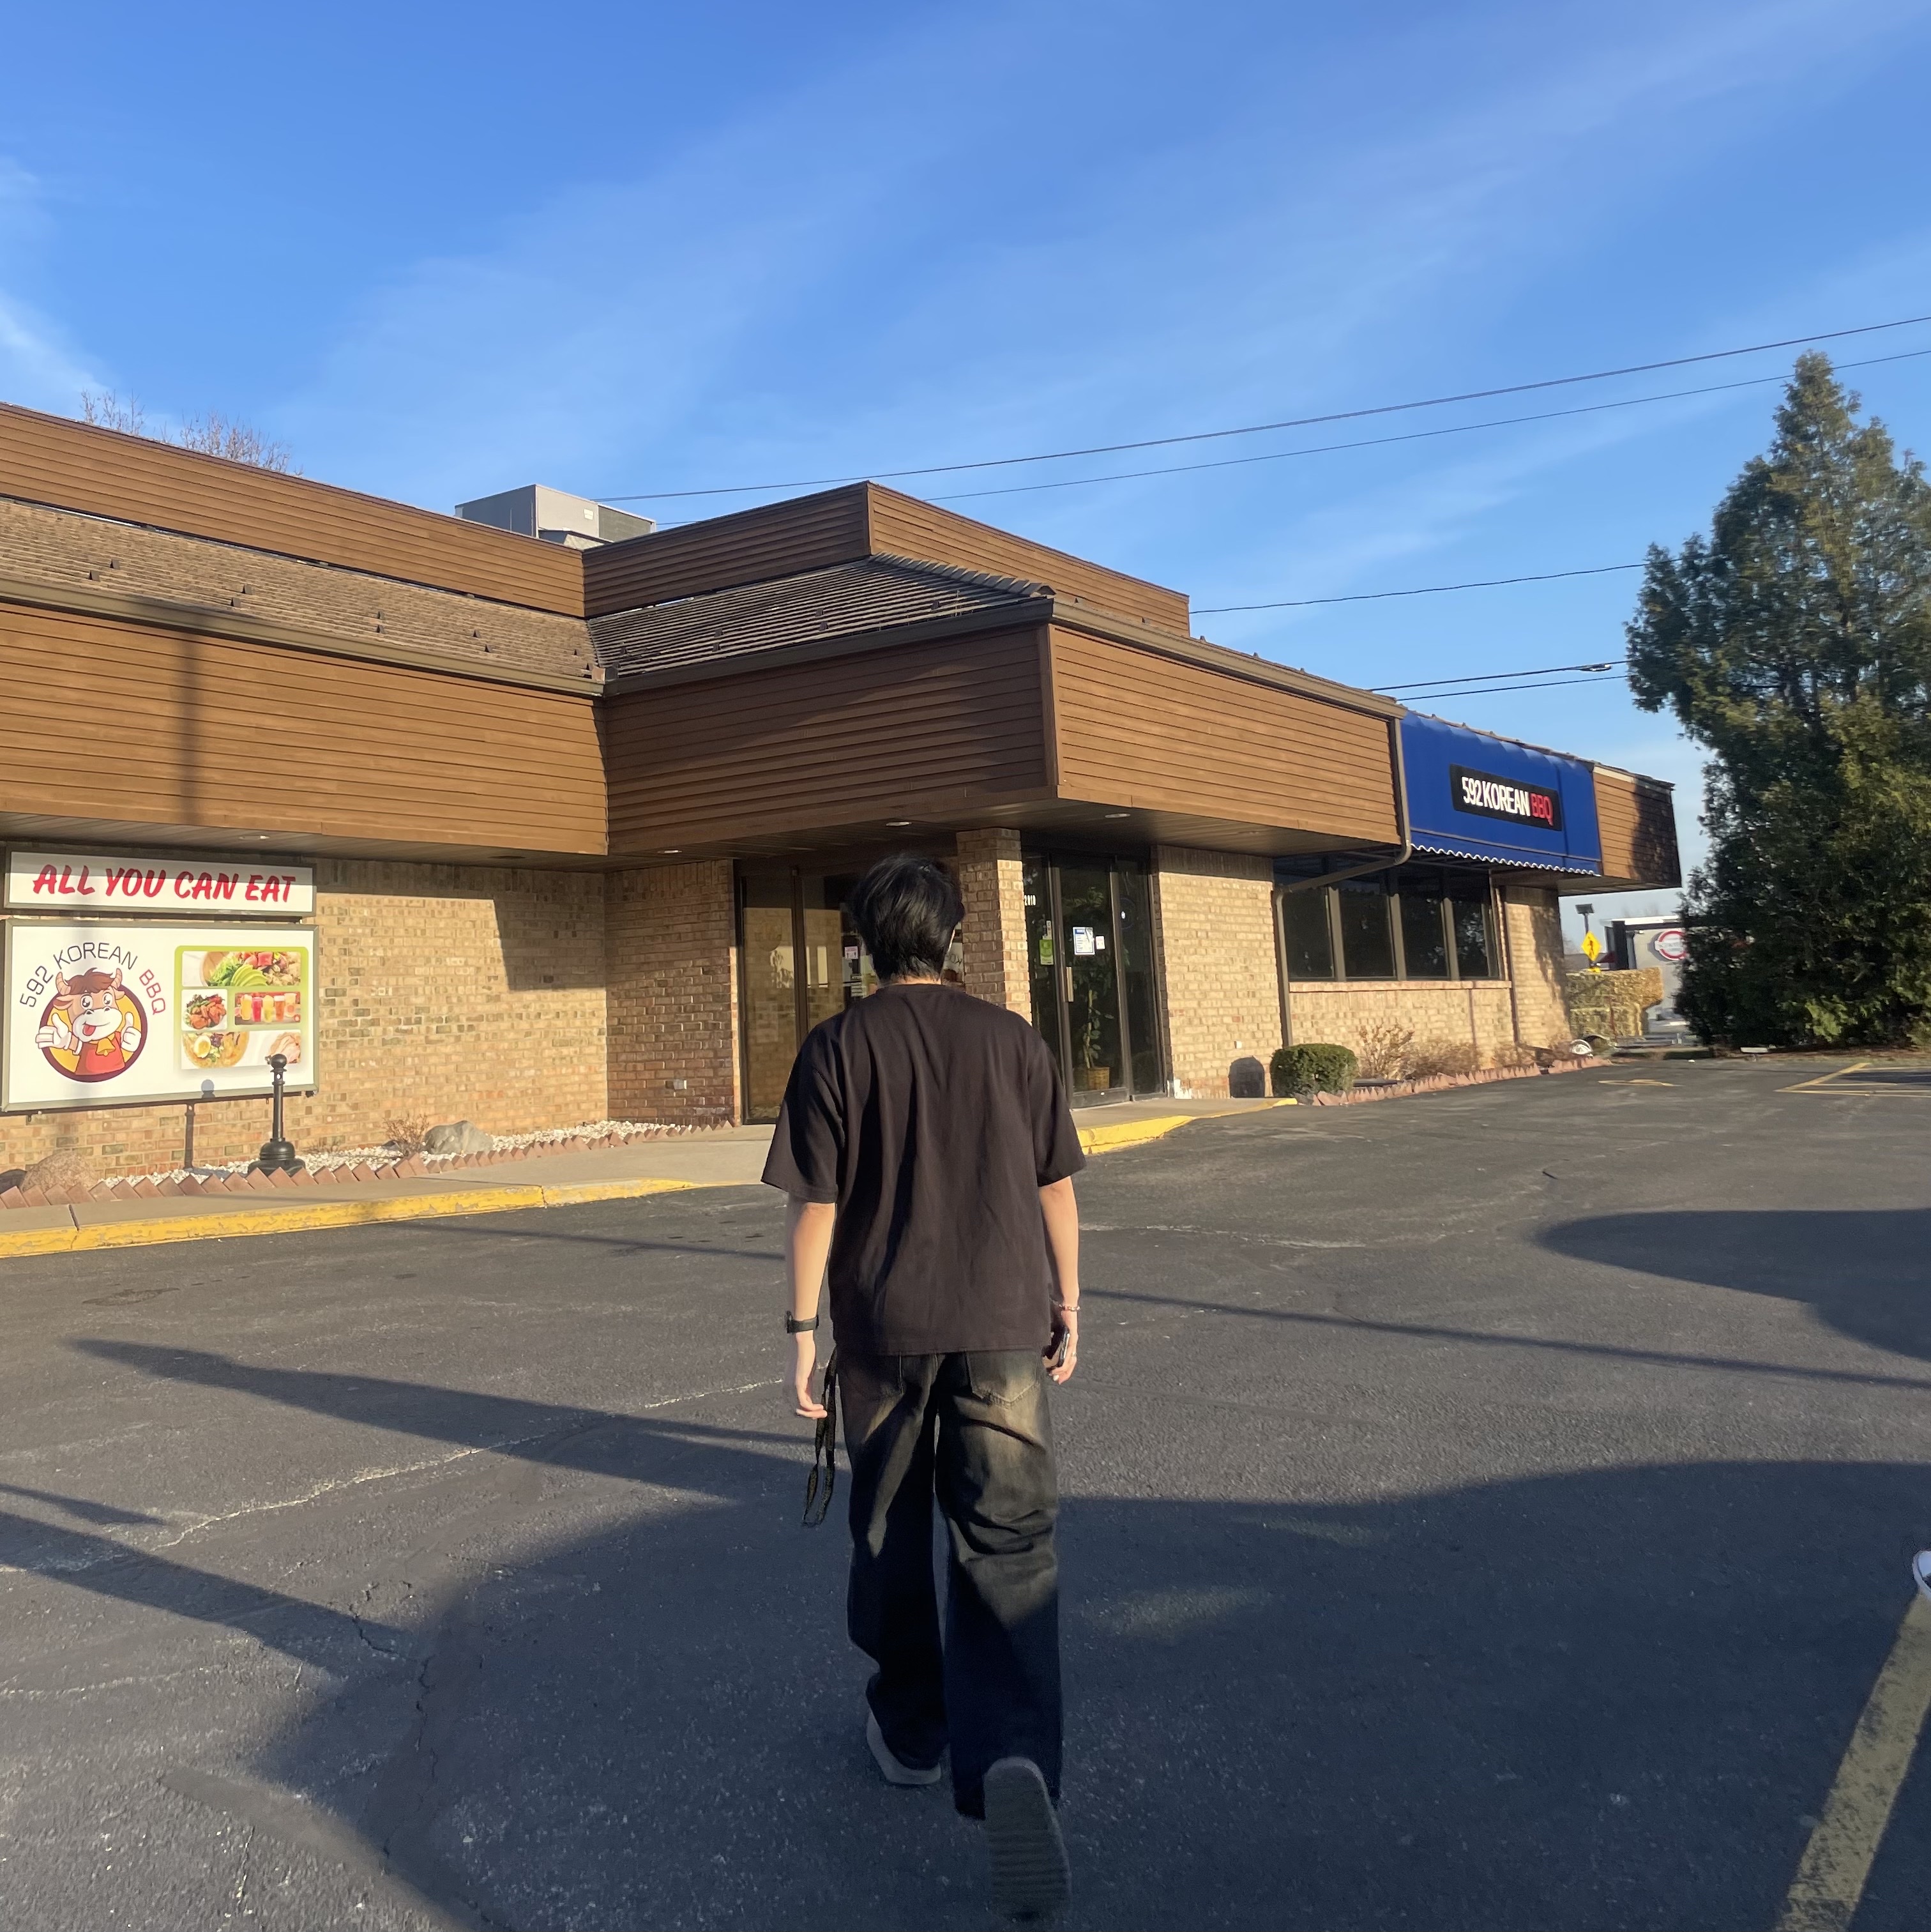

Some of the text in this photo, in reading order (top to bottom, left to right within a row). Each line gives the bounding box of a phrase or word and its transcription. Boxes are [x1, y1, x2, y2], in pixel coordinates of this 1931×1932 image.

[1481, 780, 1531, 817] KOREAN
[1529, 793, 1554, 826] BBQ
[33, 863, 296, 903] ALL YOU CAN EAT
[20, 942, 166, 1015] 592 KOREAN BBQ
